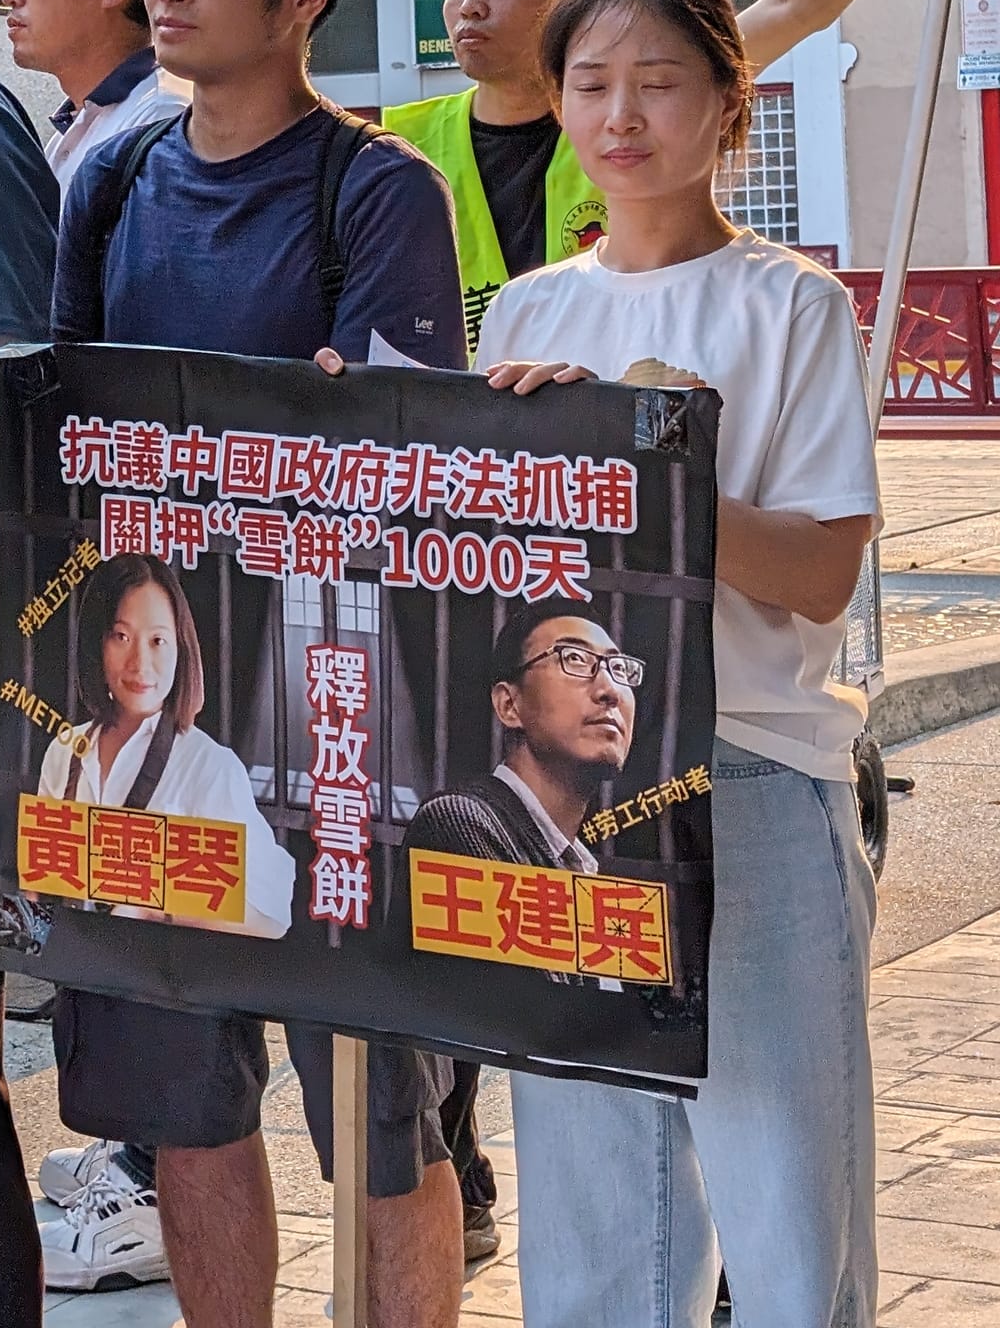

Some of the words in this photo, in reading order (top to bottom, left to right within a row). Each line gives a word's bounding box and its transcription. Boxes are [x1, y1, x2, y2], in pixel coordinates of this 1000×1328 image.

[415, 317, 434, 329] Lee
[60, 415, 638, 534] 抗議中國政府非法抓捕
[17, 537, 100, 638] #独立记者
[0, 678, 91, 758] #METOO
[306, 643, 371, 928] 釋放雪餅
[582, 764, 713, 845] #劳工行动者
[416, 860, 662, 976] 王建兵
